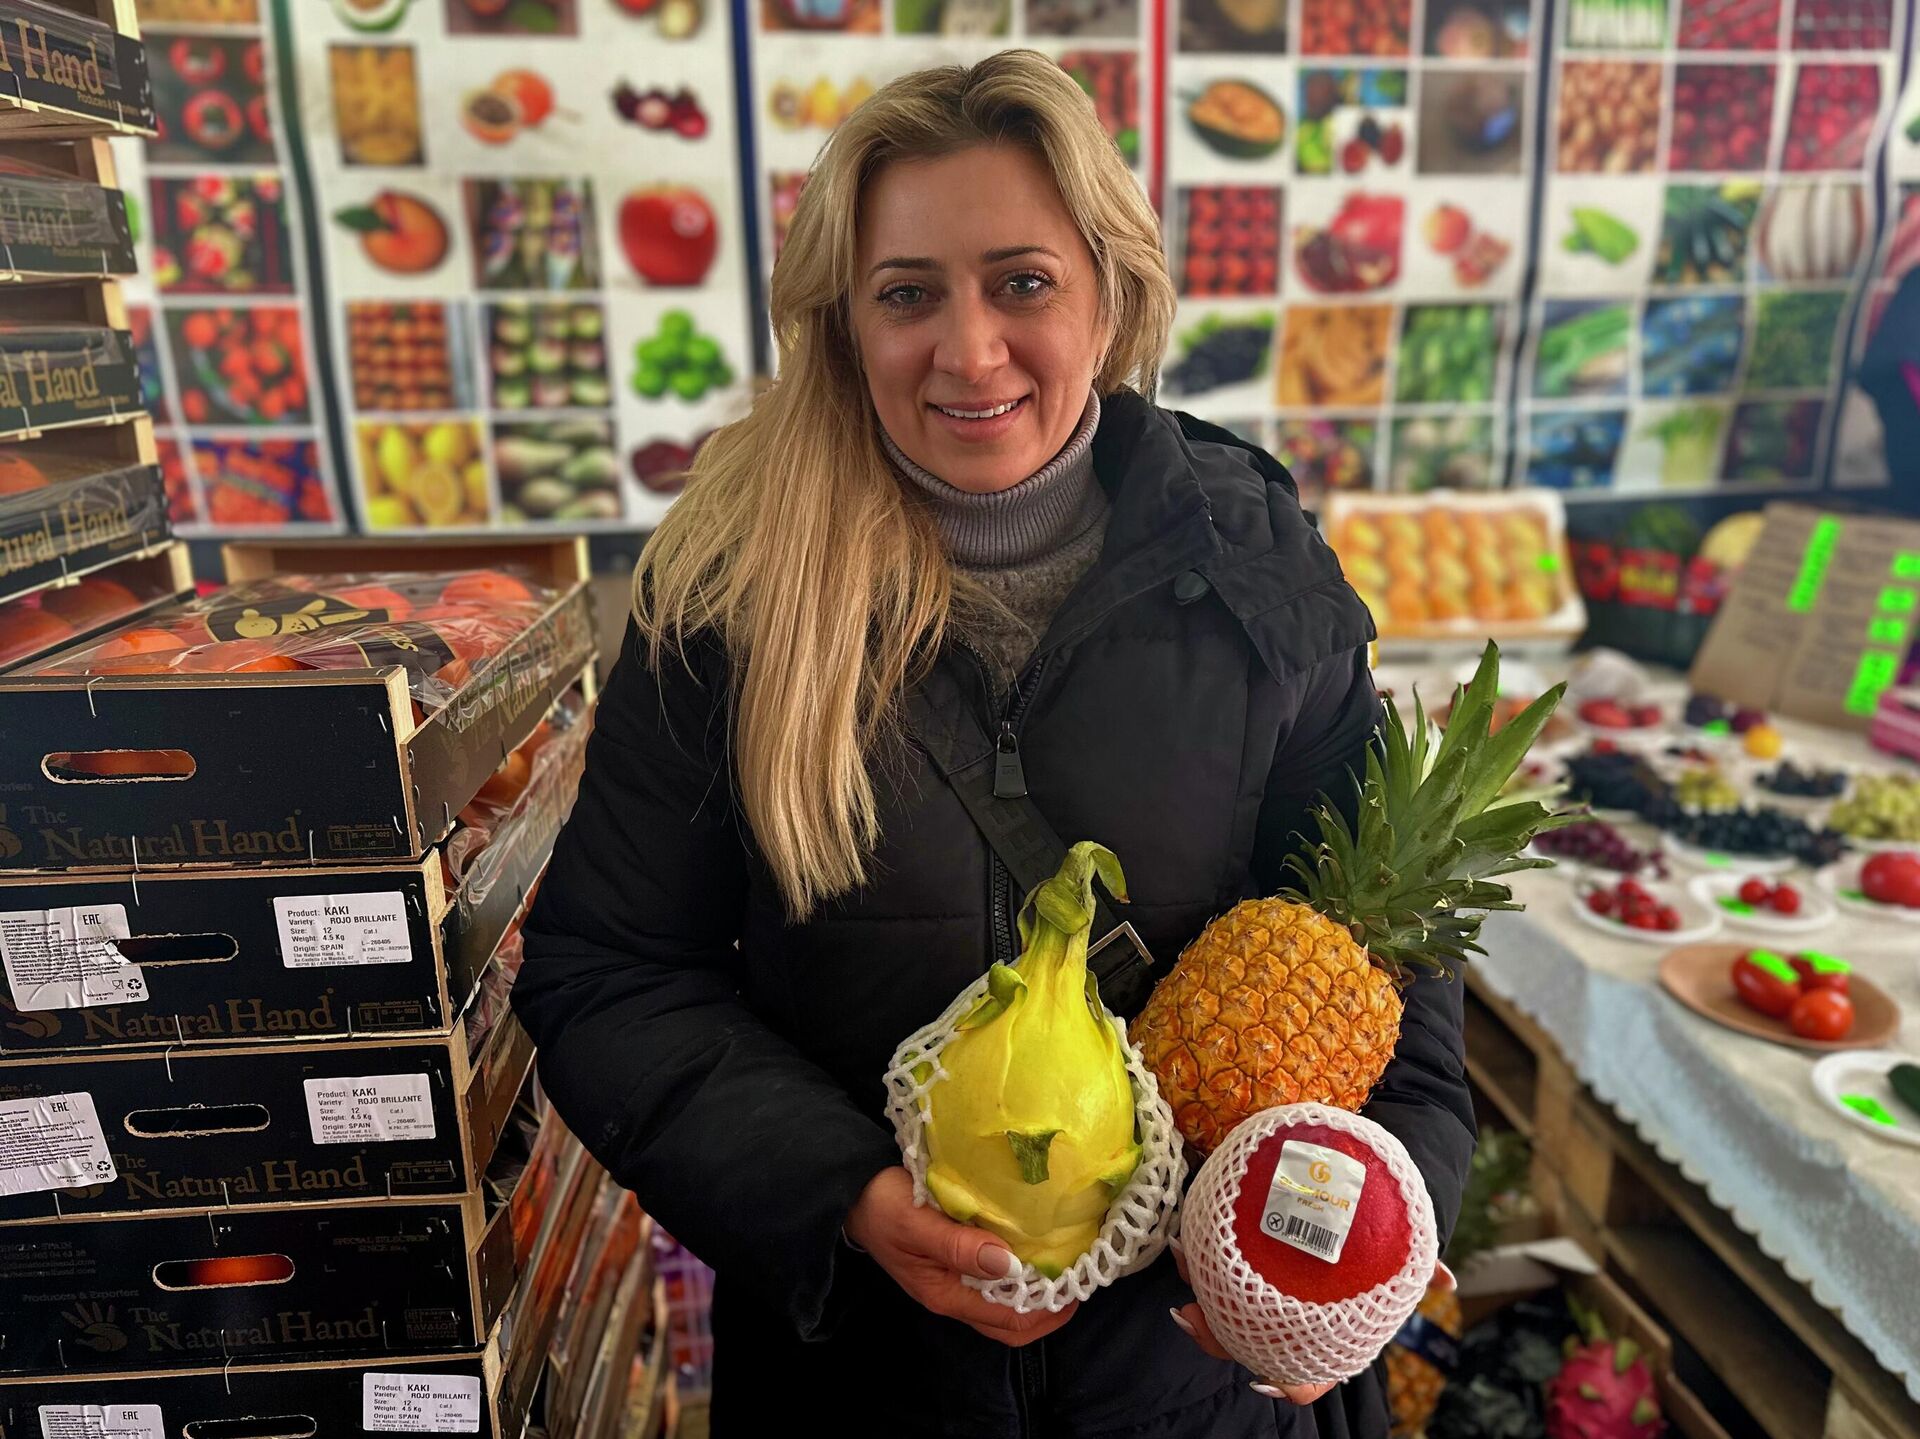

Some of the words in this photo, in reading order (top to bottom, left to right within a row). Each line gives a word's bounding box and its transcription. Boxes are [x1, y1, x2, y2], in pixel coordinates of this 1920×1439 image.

[15, 17, 105, 96] Hand
[22, 345, 99, 405] Hand
[59, 489, 129, 555] Hand
[21, 805, 67, 825] The
[41, 824, 188, 861] Natural
[191, 814, 303, 858] Hand
[287, 909, 320, 917] Product:
[324, 906, 349, 916] KAKI
[330, 916, 352, 924] ROJO
[354, 914, 397, 923] BRILLANTE
[82, 914, 101, 925] EAC
[83, 1004, 223, 1040] Natural
[225, 994, 337, 1036] Hand
[352, 1088, 377, 1097] KAKI
[381, 1095, 422, 1103] BRILLANTE
[51, 1102, 70, 1113] EAC
[126, 1171, 259, 1200] Natural
[261, 1154, 368, 1191] Hand
[129, 1307, 168, 1322] The
[147, 1319, 273, 1352] Natural
[276, 1305, 380, 1343] Hand
[407, 1384, 430, 1392] KAKI
[122, 1411, 139, 1420] EAC
